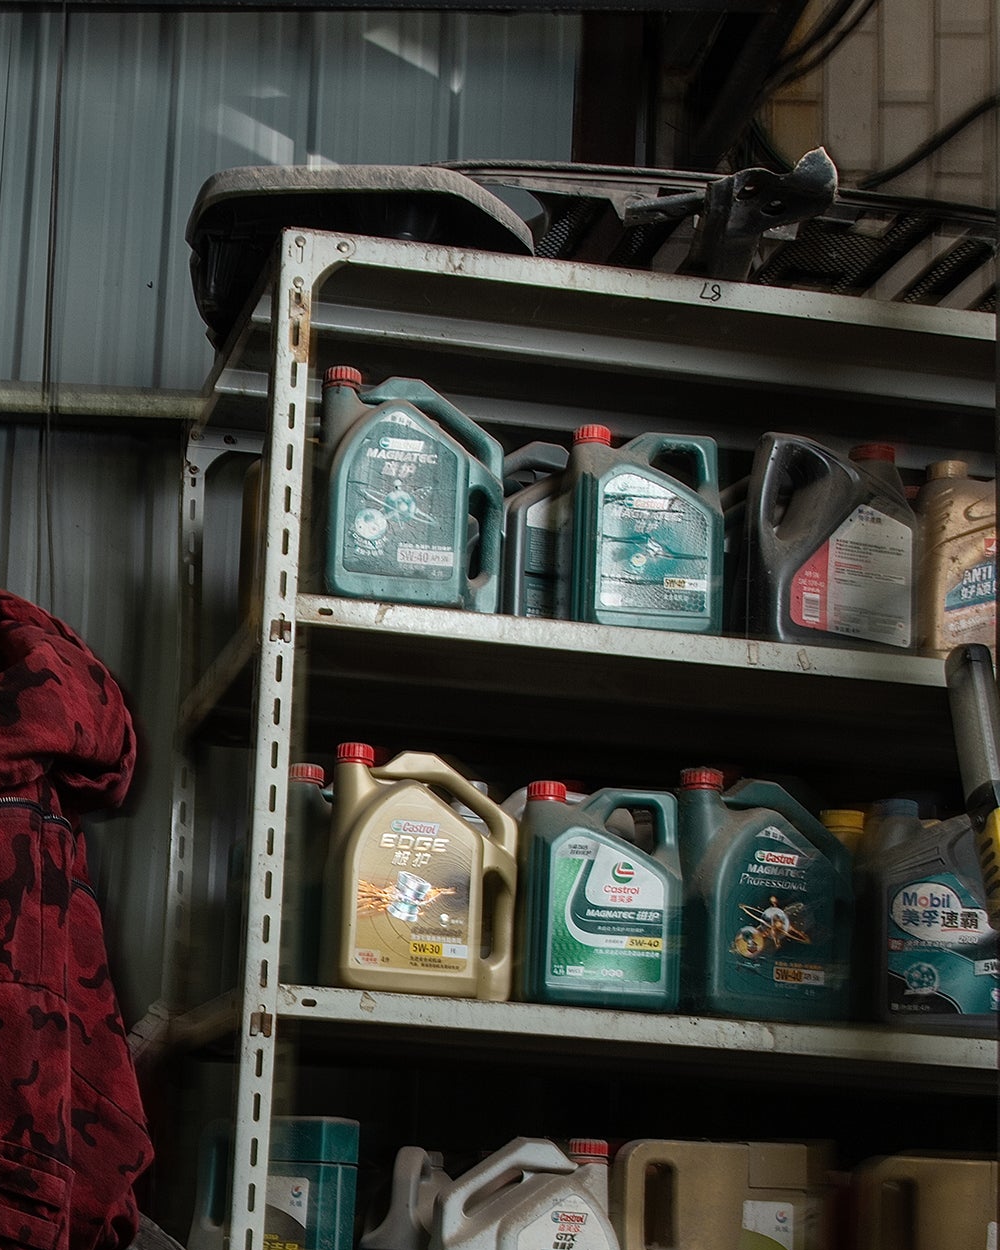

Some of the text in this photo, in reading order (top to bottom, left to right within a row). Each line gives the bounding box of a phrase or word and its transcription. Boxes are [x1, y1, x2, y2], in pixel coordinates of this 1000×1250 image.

[366, 447, 439, 465] MAGNATEC
[402, 821, 437, 835] Castrol
[378, 832, 451, 854] EDGE
[766, 852, 795, 865] Castrol
[602, 885, 640, 895] Castrol
[902, 892, 951, 909] Mobil
[585, 908, 636, 920] MAGNATEC
[902, 909, 979, 930] 美孚速霸
[412, 942, 441, 955] 5W-30
[628, 938, 660, 948] 5W-40
[559, 1213, 584, 1223] Castrol
[556, 1232, 577, 1242] GTX
